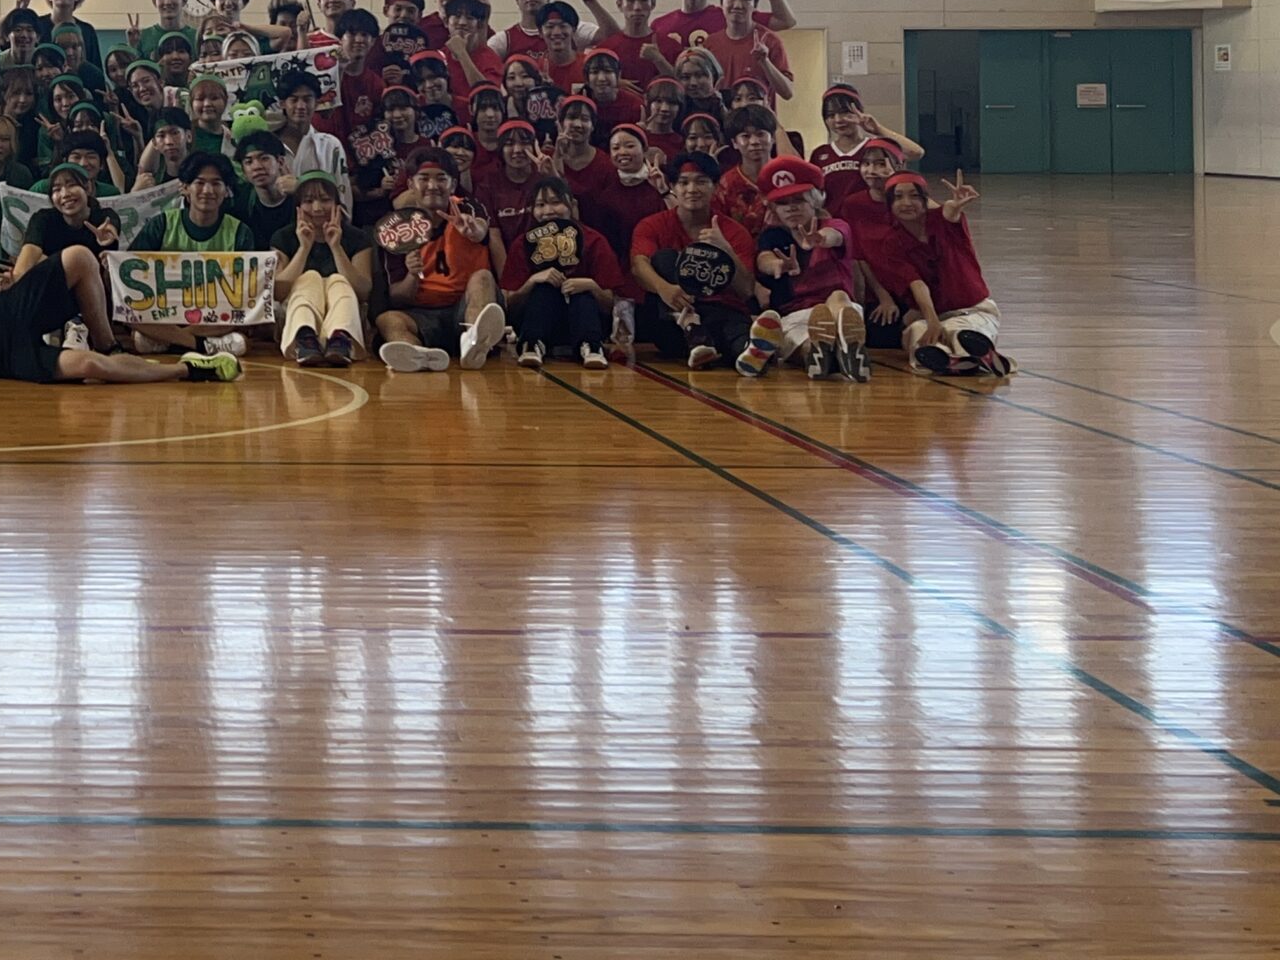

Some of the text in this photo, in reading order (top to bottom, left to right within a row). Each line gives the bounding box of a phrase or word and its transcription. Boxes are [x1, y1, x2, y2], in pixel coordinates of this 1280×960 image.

[378, 220, 432, 246] ゆうや
[436, 250, 450, 277] 4
[680, 255, 728, 288] ともや
[119, 256, 258, 311] SHIN!
[151, 305, 178, 321] ENFJ
